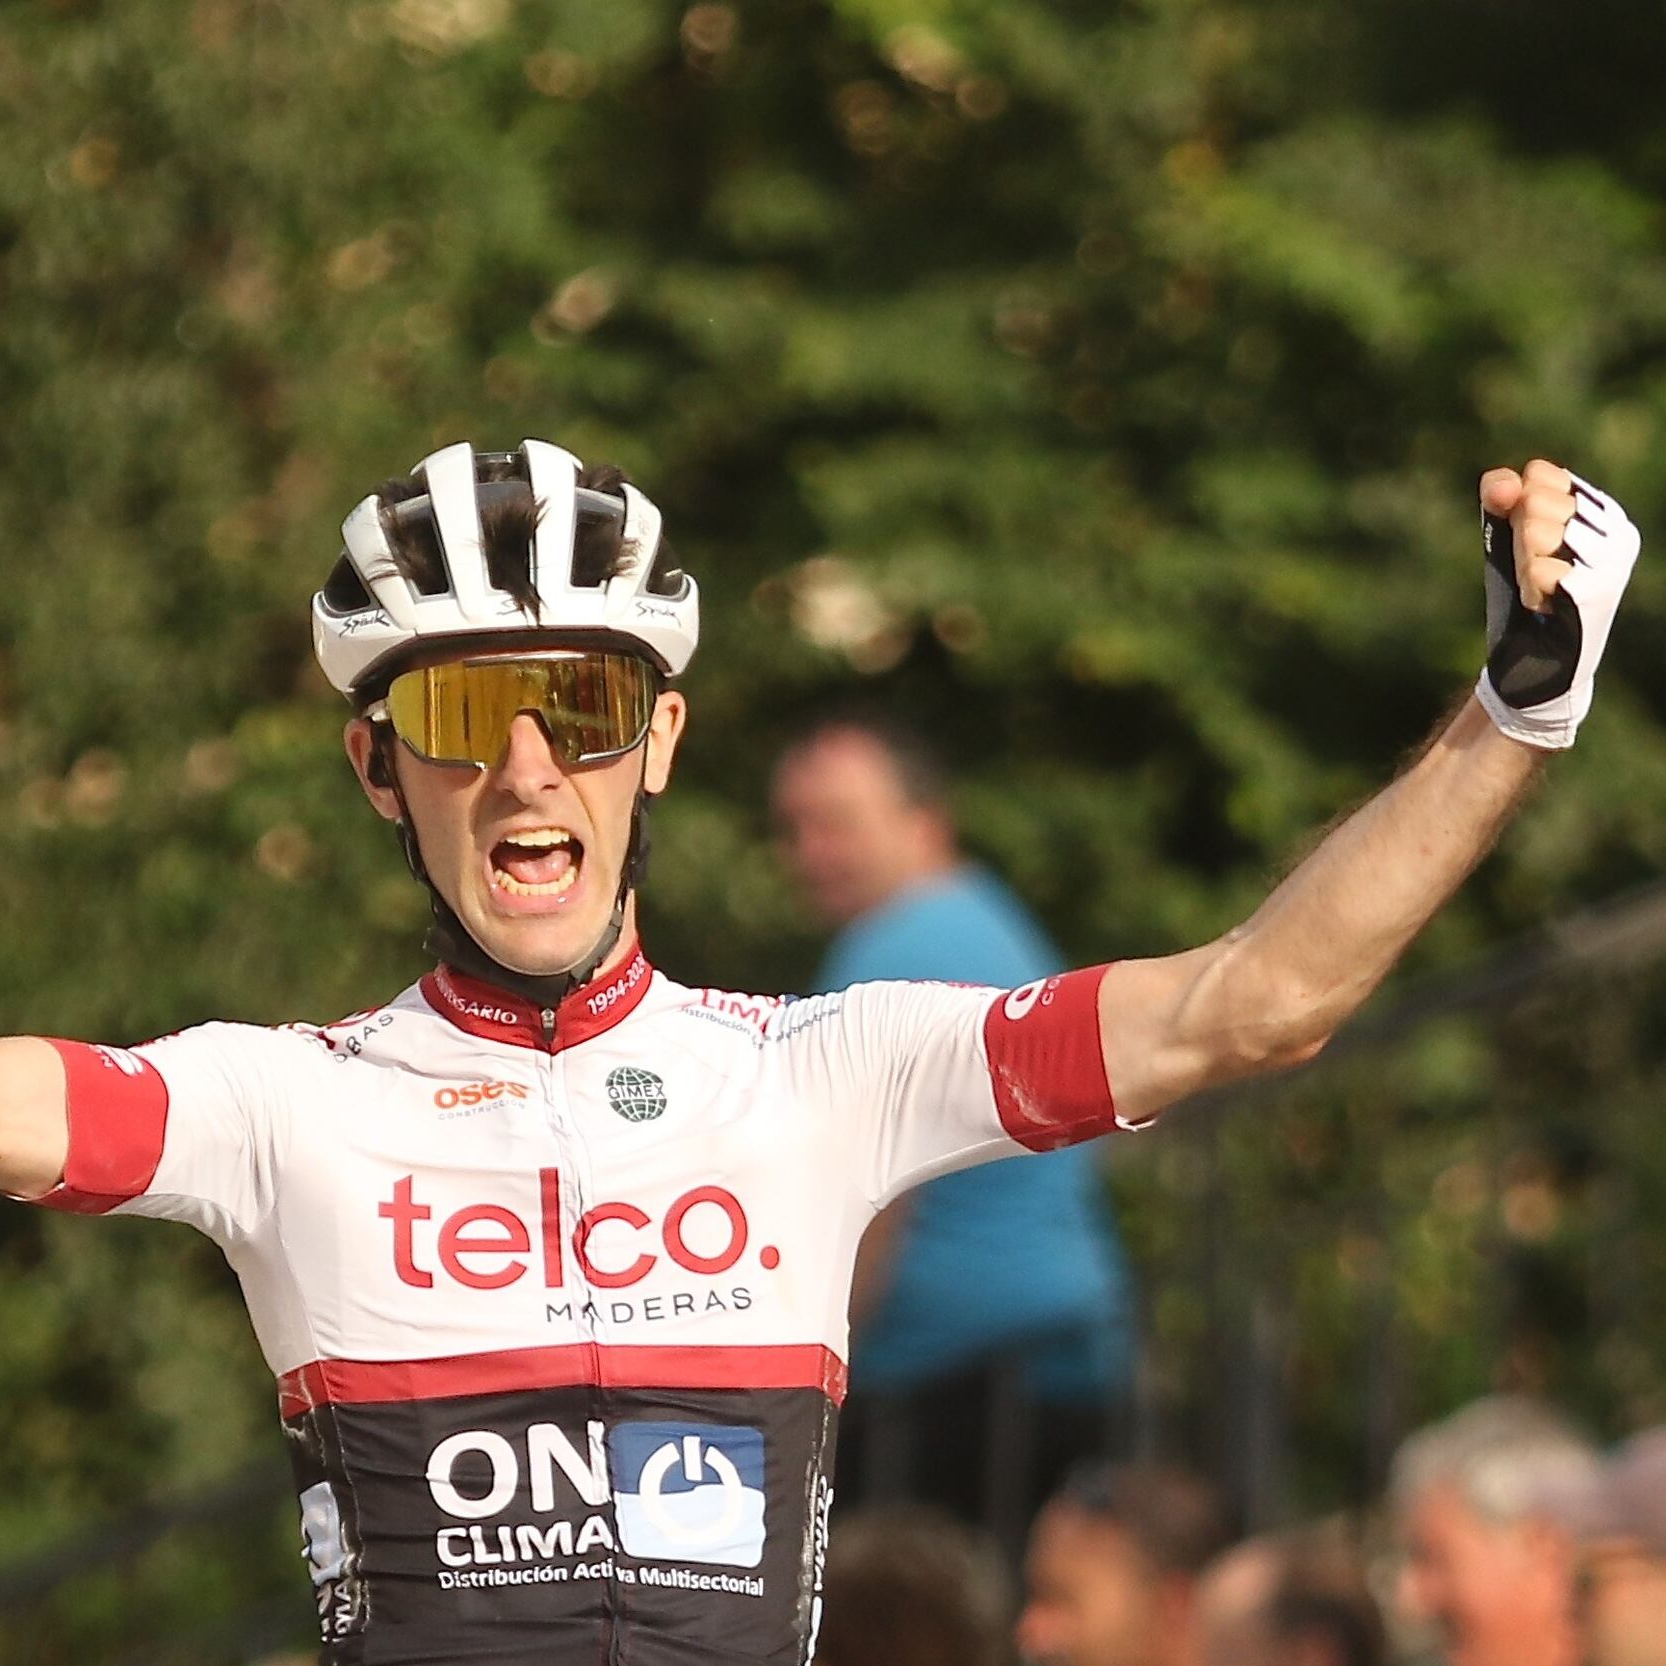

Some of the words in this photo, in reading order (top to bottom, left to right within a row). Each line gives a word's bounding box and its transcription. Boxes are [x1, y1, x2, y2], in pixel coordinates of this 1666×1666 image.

[608, 1083, 665, 1100] GIMEX
[545, 1286, 753, 1325] MADERAS
[426, 1420, 612, 1519] ON
[436, 1512, 620, 1567] CLIMA
[438, 1562, 568, 1590] Distribución
[572, 1557, 635, 1585] Activa
[638, 1566, 765, 1597] Multisectorial
